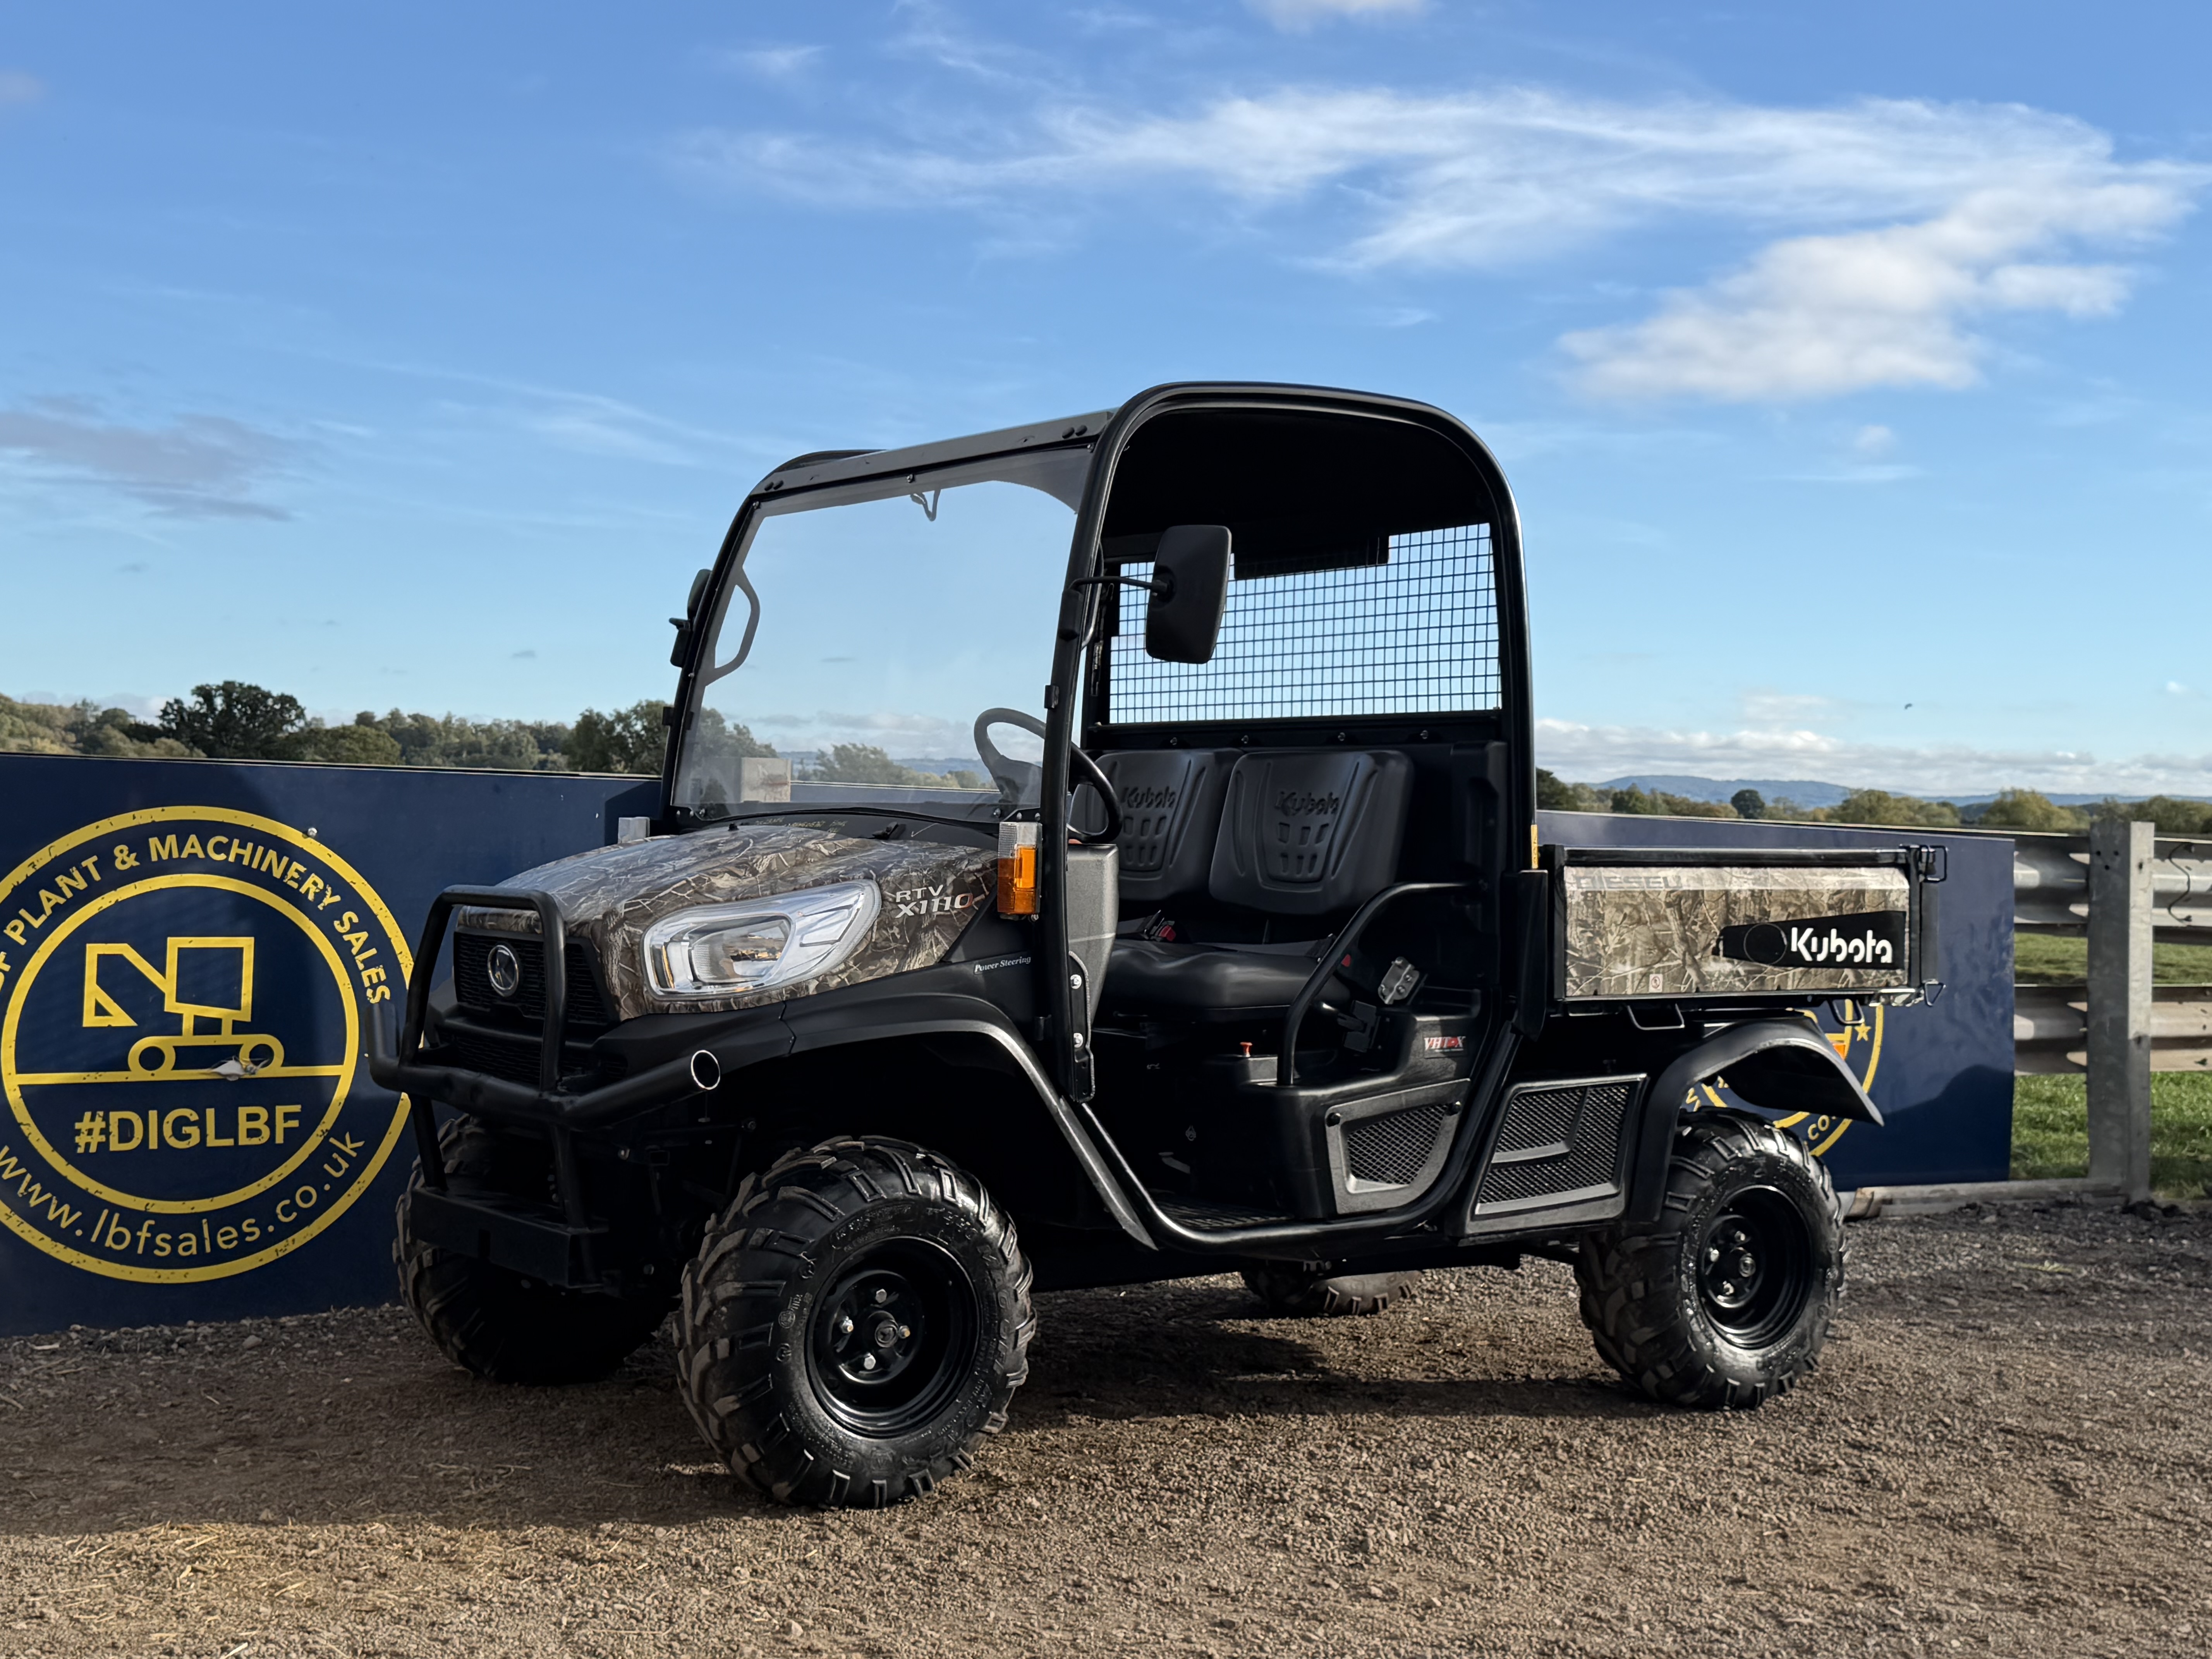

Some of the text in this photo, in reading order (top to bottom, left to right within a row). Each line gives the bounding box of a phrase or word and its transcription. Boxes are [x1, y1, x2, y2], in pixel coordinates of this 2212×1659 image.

[895, 893, 974, 919] X1110
[896, 884, 944, 903] RTV
[4, 834, 391, 1004] PLANT & MACHINERY SALES
[1791, 927, 1893, 963] Kubota
[974, 956, 1031, 973] Power Steering
[75, 1104, 302, 1154] #DIGLBF
[0, 1133, 364, 1257] www.lbfsales.co.uk
